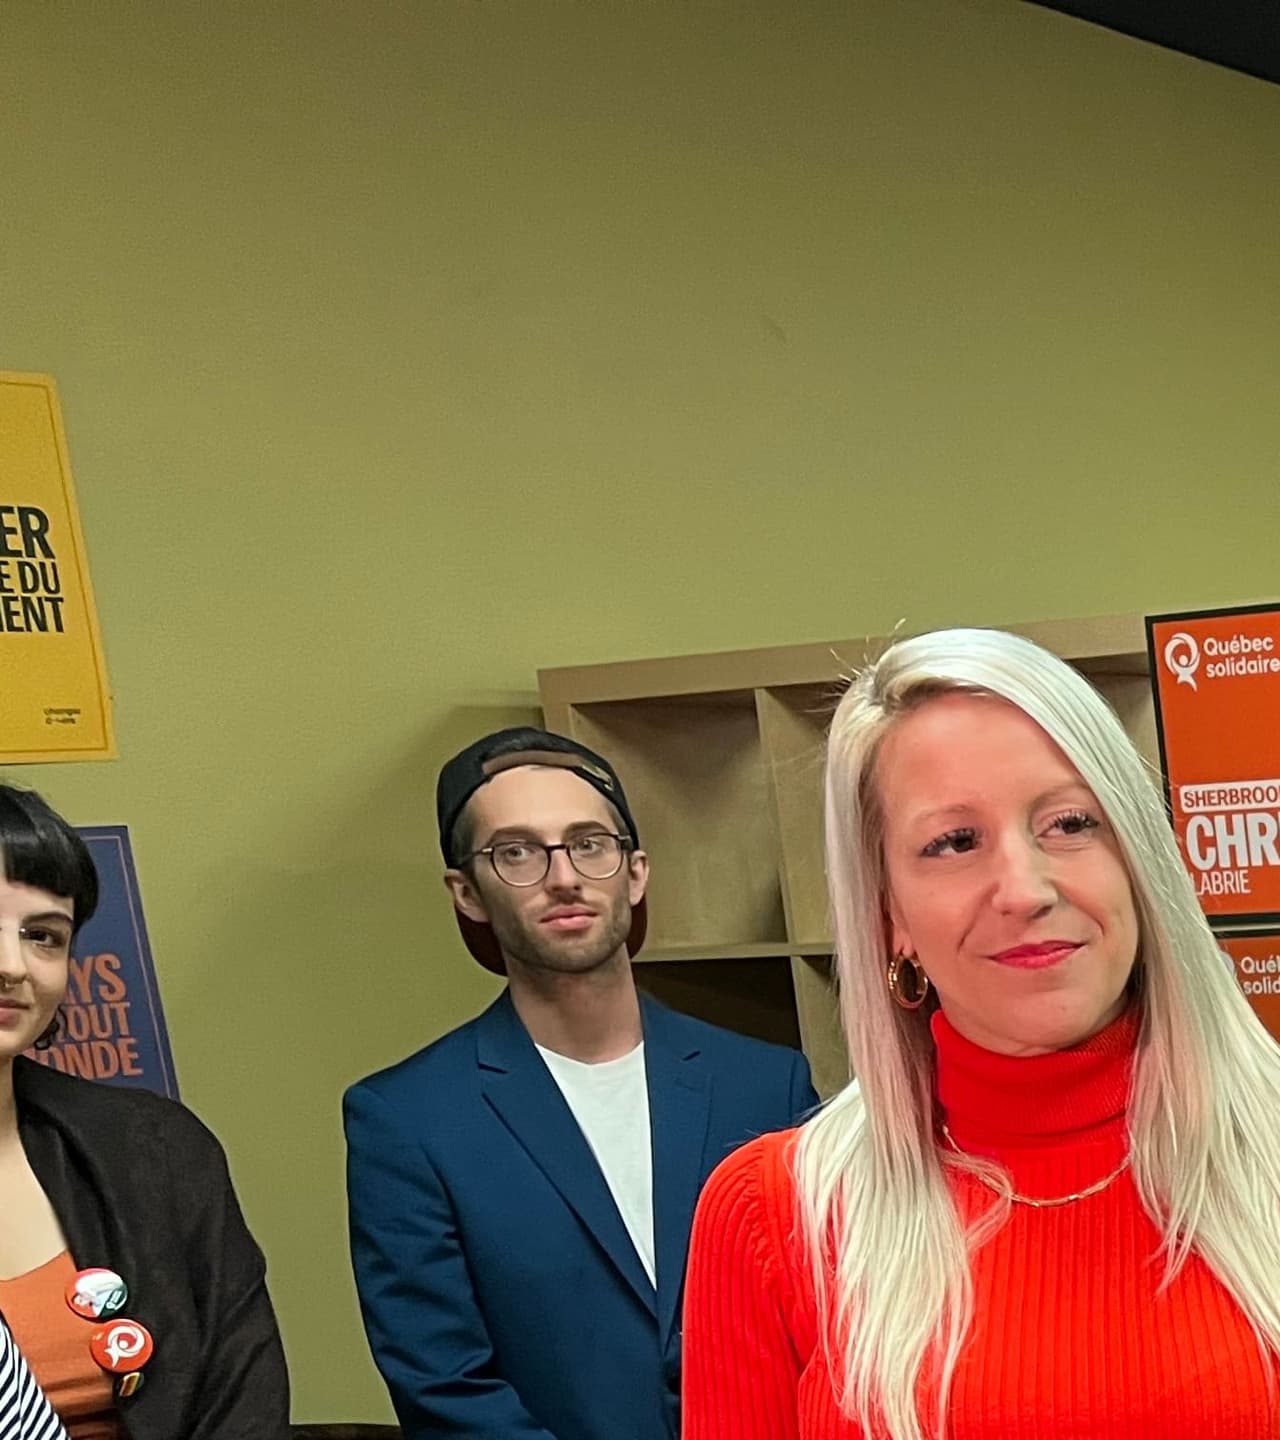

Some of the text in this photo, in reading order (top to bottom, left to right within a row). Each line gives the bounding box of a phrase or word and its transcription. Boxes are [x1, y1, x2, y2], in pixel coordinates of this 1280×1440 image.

[17, 560, 61, 594] DU
[0, 595, 64, 633] ENT
[1203, 634, 1275, 656] Québec
[1206, 654, 1280, 678] solidaire
